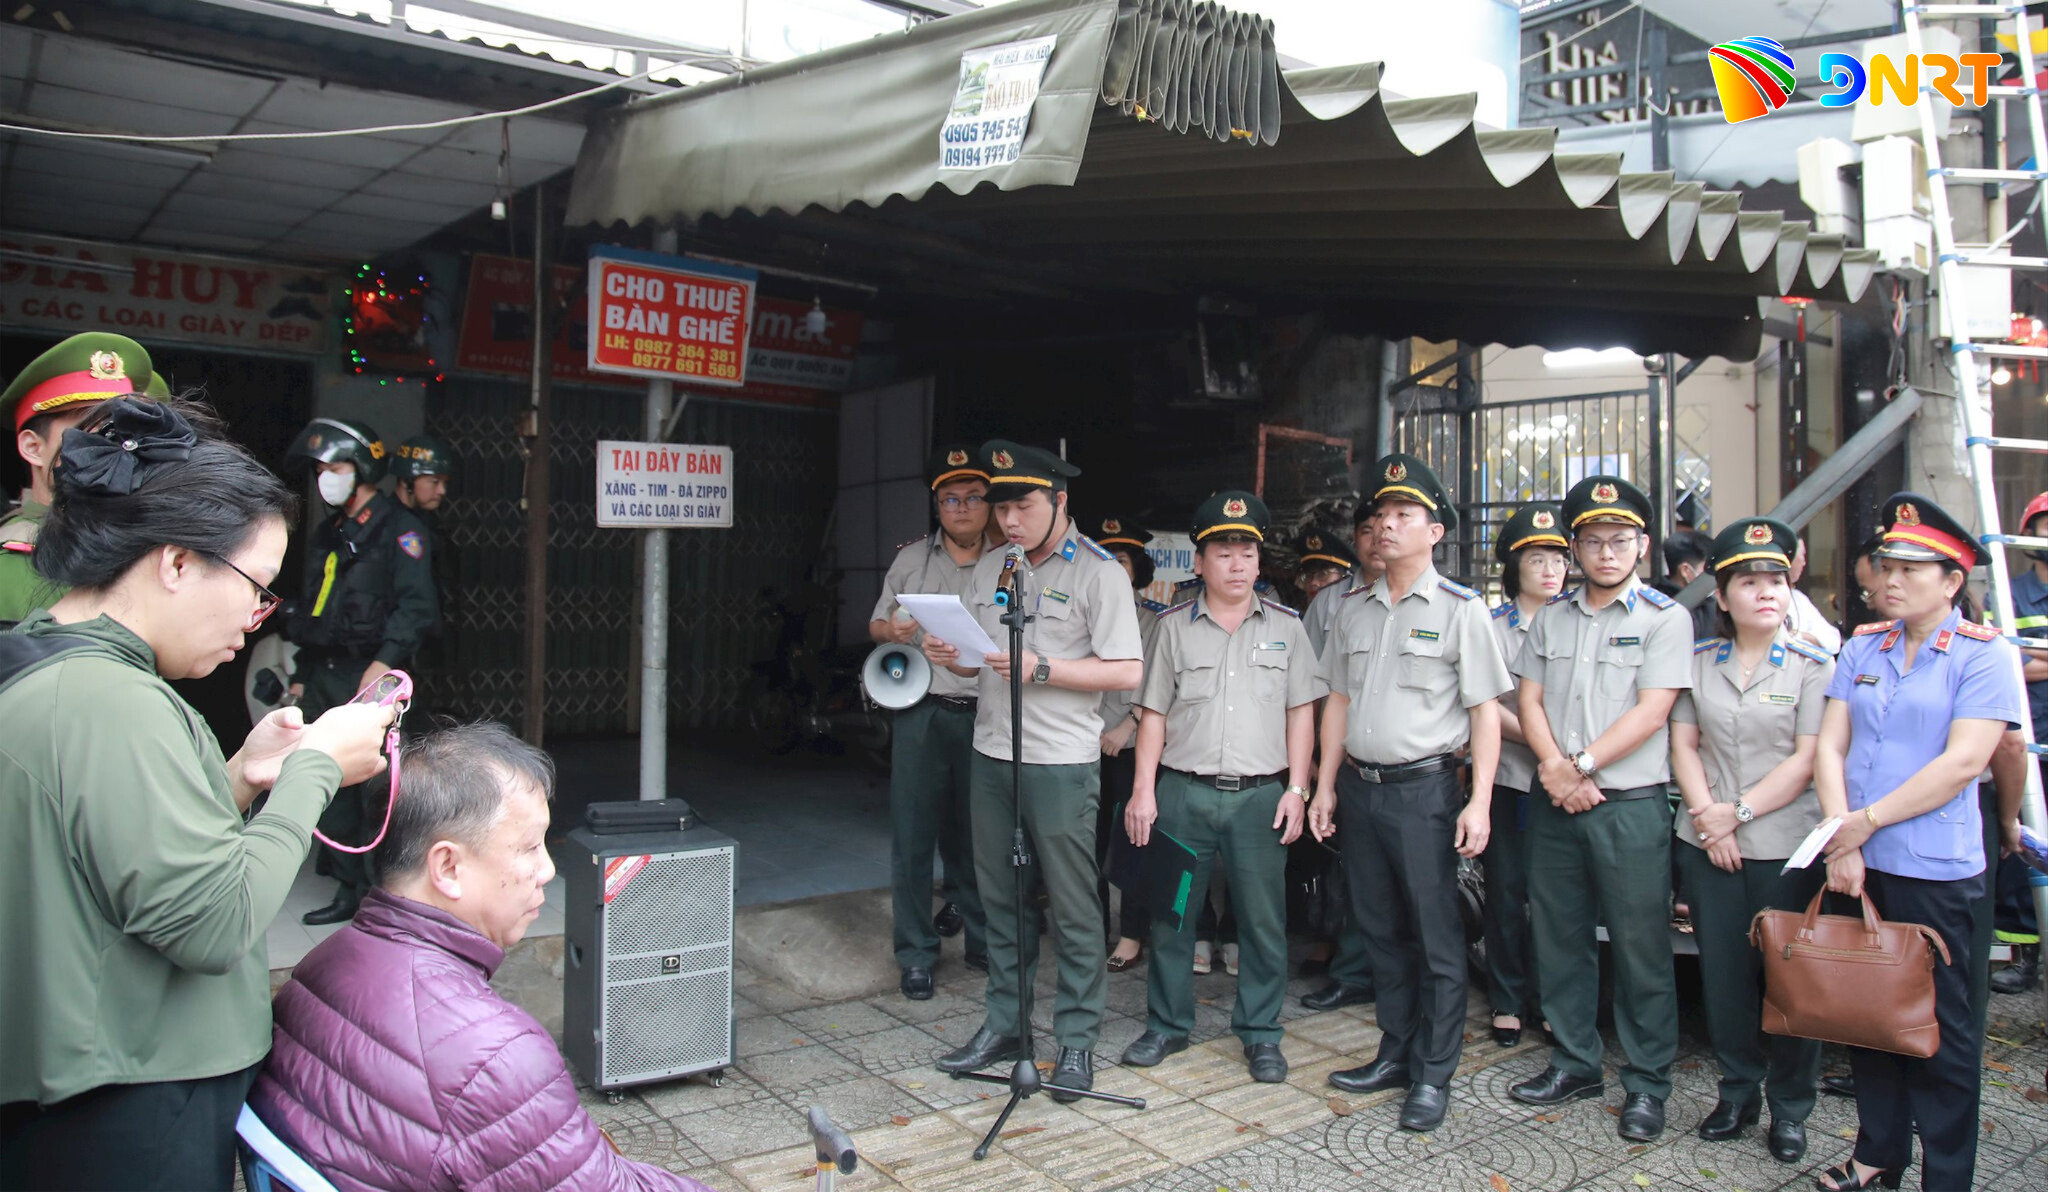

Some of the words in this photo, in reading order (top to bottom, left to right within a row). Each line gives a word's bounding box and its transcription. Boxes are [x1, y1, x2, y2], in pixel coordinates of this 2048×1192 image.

[945, 122, 978, 143] 0905
[982, 120, 1005, 141] 745
[945, 147, 981, 167] 09194
[985, 144, 1006, 165] 777
[130, 258, 269, 310] HUY
[606, 272, 664, 303] CHO
[673, 282, 742, 315] THUÊ
[21, 297, 84, 321] CÁC
[180, 313, 245, 339] GIÀY
[259, 320, 311, 342] DÉP
[605, 303, 669, 336] BÀN
[678, 315, 738, 345] GHẾ
[604, 333, 630, 350] LH:
[634, 338, 673, 355] 0987
[677, 343, 705, 360] 364
[710, 348, 737, 363] 381
[632, 353, 672, 370] 0977
[675, 358, 702, 373] 691
[708, 363, 736, 378] 569
[612, 449, 640, 476] TẠI
[646, 447, 680, 473] ĐÂY
[686, 449, 722, 475] BÁN
[605, 480, 636, 496] XĂNG
[648, 483, 668, 498] TIM
[678, 482, 693, 498] ĐÁ
[696, 485, 727, 499] ZIPPO
[611, 501, 626, 517] VÀ
[630, 500, 652, 517] CÁC
[655, 503, 680, 520] LOẠI
[683, 504, 693, 518] SI
[697, 502, 721, 519] GIÀY
